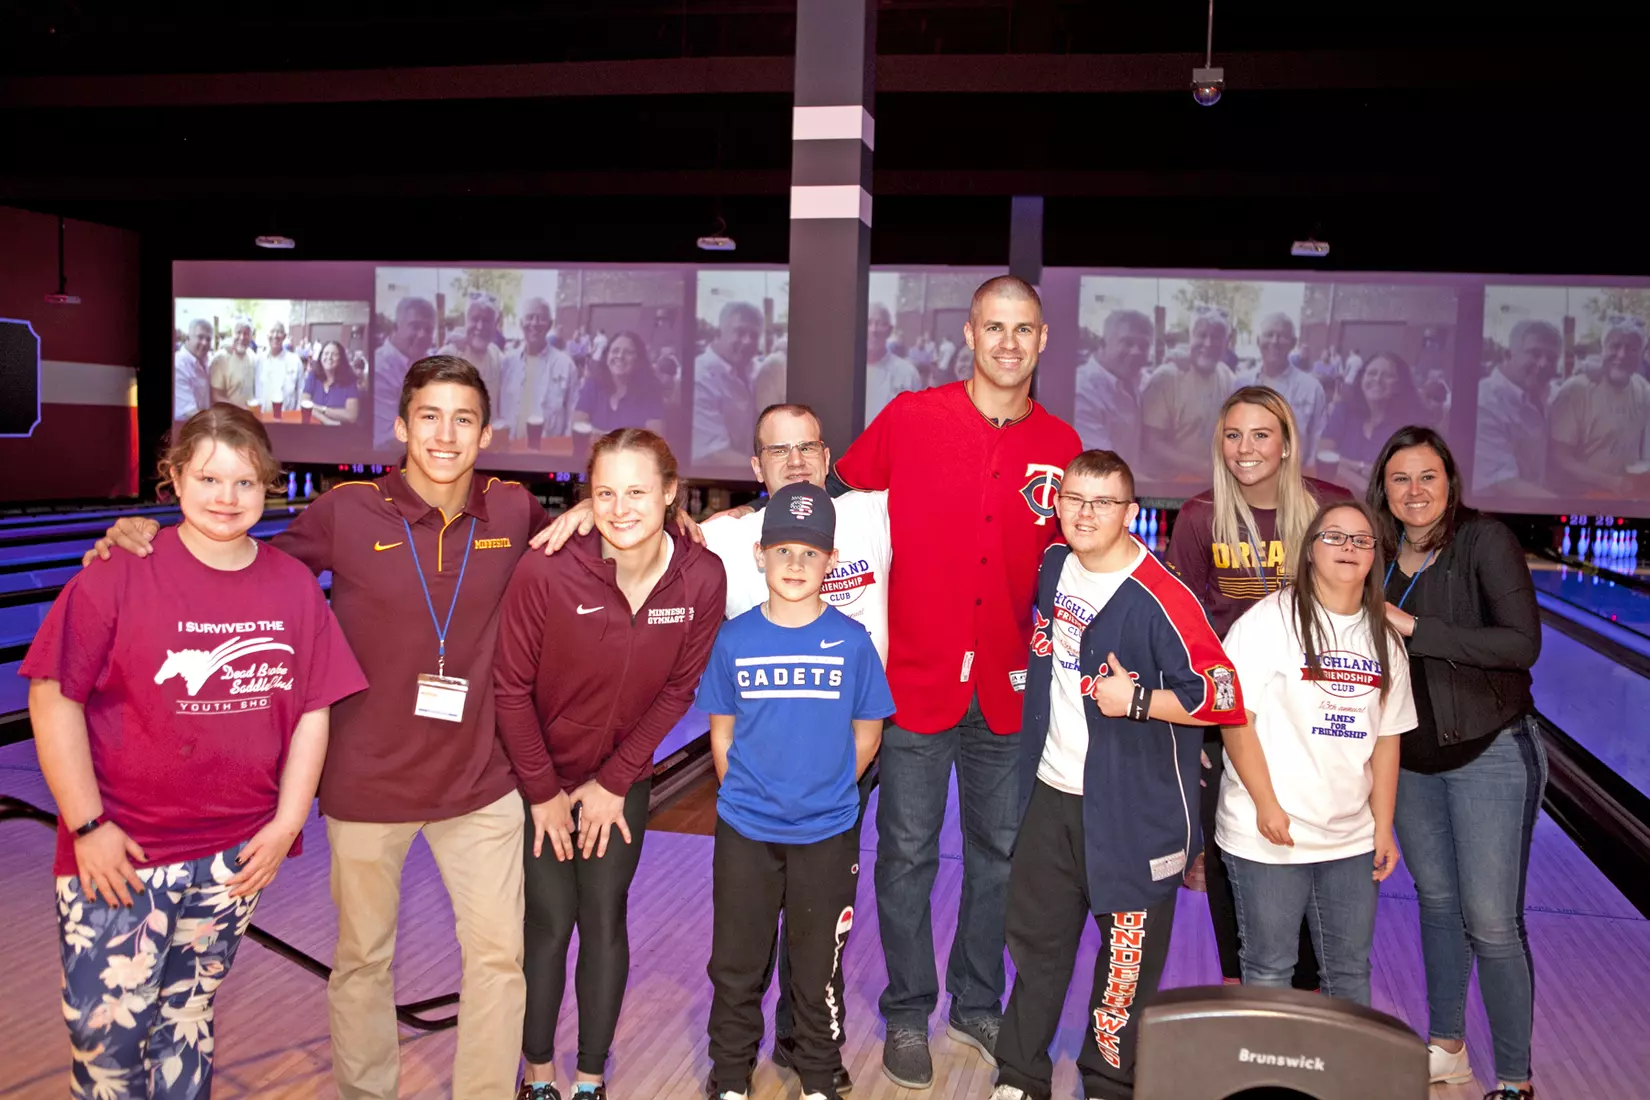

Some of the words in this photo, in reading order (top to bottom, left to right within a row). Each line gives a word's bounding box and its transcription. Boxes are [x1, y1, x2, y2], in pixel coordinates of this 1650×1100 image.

[474, 537, 512, 549] MINNESOTA
[1212, 540, 1285, 569] DREA
[820, 577, 863, 592] RIENDSHIP
[829, 592, 851, 602] CLUB
[1054, 590, 1095, 623] HIGHLA
[178, 621, 183, 632] I
[185, 621, 256, 634] SURVIVED
[257, 620, 285, 631] THE
[220, 663, 256, 680] Dead
[737, 667, 843, 687] CADETS
[1322, 671, 1374, 684] RIENDSHIP
[1331, 683, 1355, 692] CLUB
[180, 702, 231, 712] YOUTH
[240, 698, 269, 710] SHO
[1325, 713, 1355, 723] LANES
[1311, 726, 1367, 739] FRIENDSHIP
[1331, 722, 1346, 730] FOR
[1238, 1048, 1325, 1072] Brunswick
